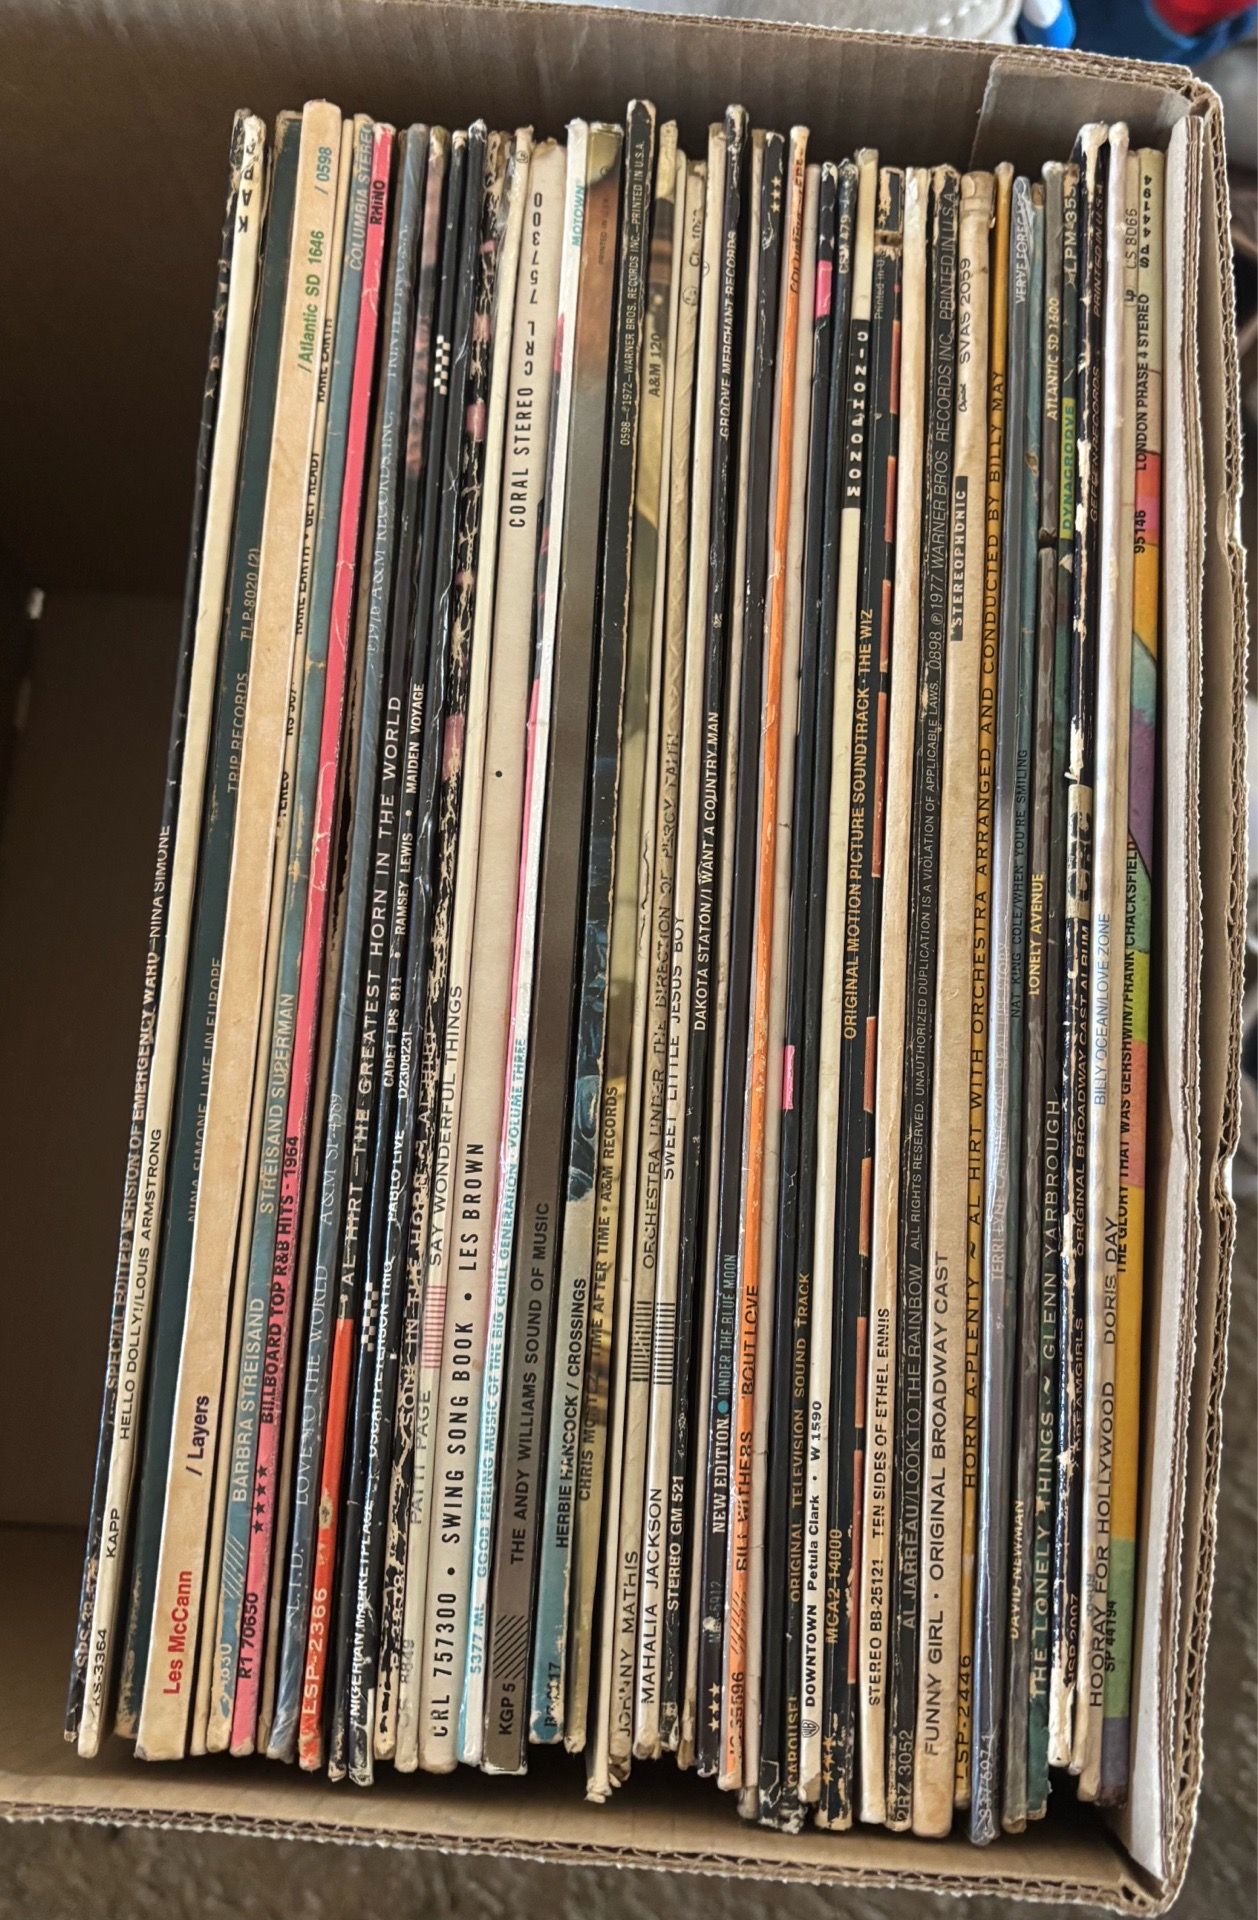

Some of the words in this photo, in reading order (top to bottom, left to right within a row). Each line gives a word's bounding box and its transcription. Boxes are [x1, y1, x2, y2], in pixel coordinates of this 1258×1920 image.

[314, 146, 332, 182] 0598
[348, 188, 368, 270] COLUMBIA
[570, 184, 586, 246] MOTOWN
[1125, 208, 1138, 246] 8066
[305, 230, 324, 264] 1646
[303, 274, 320, 296] SD
[625, 256, 640, 299] RECORDS
[958, 258, 972, 303] 2059
[1014, 263, 1027, 303] VERVE
[1047, 333, 1059, 350] SD
[1136, 294, 1149, 347] STEREO
[648, 364, 662, 398] A&M
[1136, 363, 1148, 407] PHASE
[512, 386, 536, 455] STEREO
[846, 331, 870, 496] MONOPHONIC
[1135, 409, 1148, 470] LONDON
[1061, 404, 1075, 530] DYNAGROOVE
[506, 468, 530, 528] CORAL
[951, 490, 967, 626] STEREOPHONIC
[857, 608, 873, 638] WIZ
[855, 644, 871, 676] THE
[928, 632, 944, 670] 0898
[409, 683, 425, 734] VOYAGE
[705, 712, 721, 746] MAN
[979, 688, 994, 734] AND
[381, 696, 402, 780] WORLD
[850, 688, 869, 803] SOUNDTRACK
[226, 755, 242, 792] TRIP
[405, 742, 421, 793] MAIDEN
[702, 750, 718, 821] COUNTRY
[377, 794, 396, 838] THE
[923, 796, 935, 811] OF
[975, 748, 992, 876] ARRANGED
[399, 833, 414, 873] LEWIS
[701, 826, 716, 836] A
[847, 807, 864, 880] PICTURE
[920, 814, 934, 880] VIOLATION
[375, 852, 392, 874] IN
[699, 841, 715, 882] WANT
[394, 881, 411, 934] RAMSEY
[919, 897, 931, 908] IS
[920, 884, 932, 894] A
[1030, 874, 1044, 934] AVENUE
[369, 888, 389, 956] HORN
[845, 884, 862, 952] MOTION
[1096, 914, 1110, 956] ZONE
[971, 891, 988, 1034] ORCHESTRA
[1028, 940, 1043, 995] LONELY
[386, 1009, 399, 1034] LPS
[692, 968, 710, 1031] DAKOTA
[843, 956, 860, 1040] ORIGINAL
[1010, 992, 1022, 1018] NAT
[269, 993, 294, 1099] SUPERMAN
[358, 969, 384, 1094] GREATEST
[383, 1042, 398, 1088] CADET
[970, 1049, 984, 1109] WITH
[601, 1086, 618, 1160] RECORDS
[1075, 1049, 1087, 1157] BROADWAY
[125, 1124, 141, 1150] OF
[259, 1104, 284, 1214] STREISAND
[280, 1136, 298, 1178] 1964
[969, 1124, 983, 1180] HIRT
[317, 1169, 337, 1226] A&M
[462, 1142, 483, 1220] BROWN
[598, 1166, 614, 1202] A&M
[910, 1174, 923, 1222] RIGHTS
[276, 1196, 294, 1234] HITS
[531, 1202, 550, 1260] MUSIC
[641, 1150, 662, 1270] ORCHESTRA
[968, 1196, 982, 1226] AL
[272, 1240, 290, 1276] R&B
[428, 1226, 444, 1266] SAY
[459, 1233, 479, 1271] LES
[593, 1216, 610, 1256] TIME
[909, 1226, 921, 1250] ALL
[990, 1237, 1005, 1281] TERRI
[1116, 1242, 1129, 1273] THE
[119, 1380, 137, 1440] HELLO
[138, 1129, 162, 1240] ARMSTRONG
[340, 1256, 358, 1286] AL
[528, 1267, 546, 1292] OF
[589, 1262, 607, 1314] AFTER
[722, 1254, 737, 1288] MOON
[932, 1251, 950, 1314] CAST
[269, 1281, 287, 1316] TOP
[907, 1264, 923, 1358] RAINBOW
[1042, 1272, 1058, 1360] GLENN
[239, 1298, 264, 1412] STREISAND
[450, 1323, 471, 1382] BOOK
[524, 1300, 543, 1364] SOUND
[303, 1354, 322, 1394] THE
[794, 1338, 808, 1398] SOUND
[874, 1364, 889, 1418] ETHEL
[906, 1362, 922, 1402] THE
[930, 1322, 948, 1460] BROADWAY
[185, 1395, 210, 1460] Layers
[414, 1390, 431, 1450] PAGE
[446, 1395, 467, 1455] SONG
[515, 1372, 537, 1460] WILLIAMS
[555, 1486, 574, 1548] HERBIE
[565, 1278, 587, 1376] CROSSINGS
[810, 1400, 823, 1442] 1590
[873, 1424, 888, 1444] OF
[906, 1408, 921, 1434] TO
[232, 1418, 255, 1502] BARBRA
[810, 1446, 822, 1461] W
[964, 1415, 978, 1488] HORN
[442, 1470, 463, 1544] SWING
[512, 1468, 530, 1520] ANDY
[670, 1475, 684, 1502] 521
[711, 1492, 728, 1533] NEW
[105, 1508, 122, 1558] KAPP
[645, 1488, 662, 1589] JACKSON
[669, 1508, 684, 1535] GM
[808, 1494, 820, 1536] Clark
[928, 1468, 946, 1580] ORIGINAL
[510, 1528, 527, 1564] THE
[807, 1540, 820, 1592] Petula
[167, 1570, 192, 1652] McCann
[622, 1551, 639, 1634] MATHIS
[434, 1592, 456, 1678] 757300
[470, 1632, 485, 1676] 5377
[804, 1604, 818, 1708] DOWNTOWN
[927, 1610, 944, 1664] GIRL
[1088, 1606, 1106, 1708] HOORAY
[164, 1660, 184, 1694] Les
[238, 1655, 254, 1679] R1
[1103, 1651, 1116, 1672] SP
[500, 1683, 517, 1693] 5
[498, 1698, 516, 1735] KGP
[926, 1672, 943, 1756] FUNNY
[898, 1730, 914, 1776] 3052
